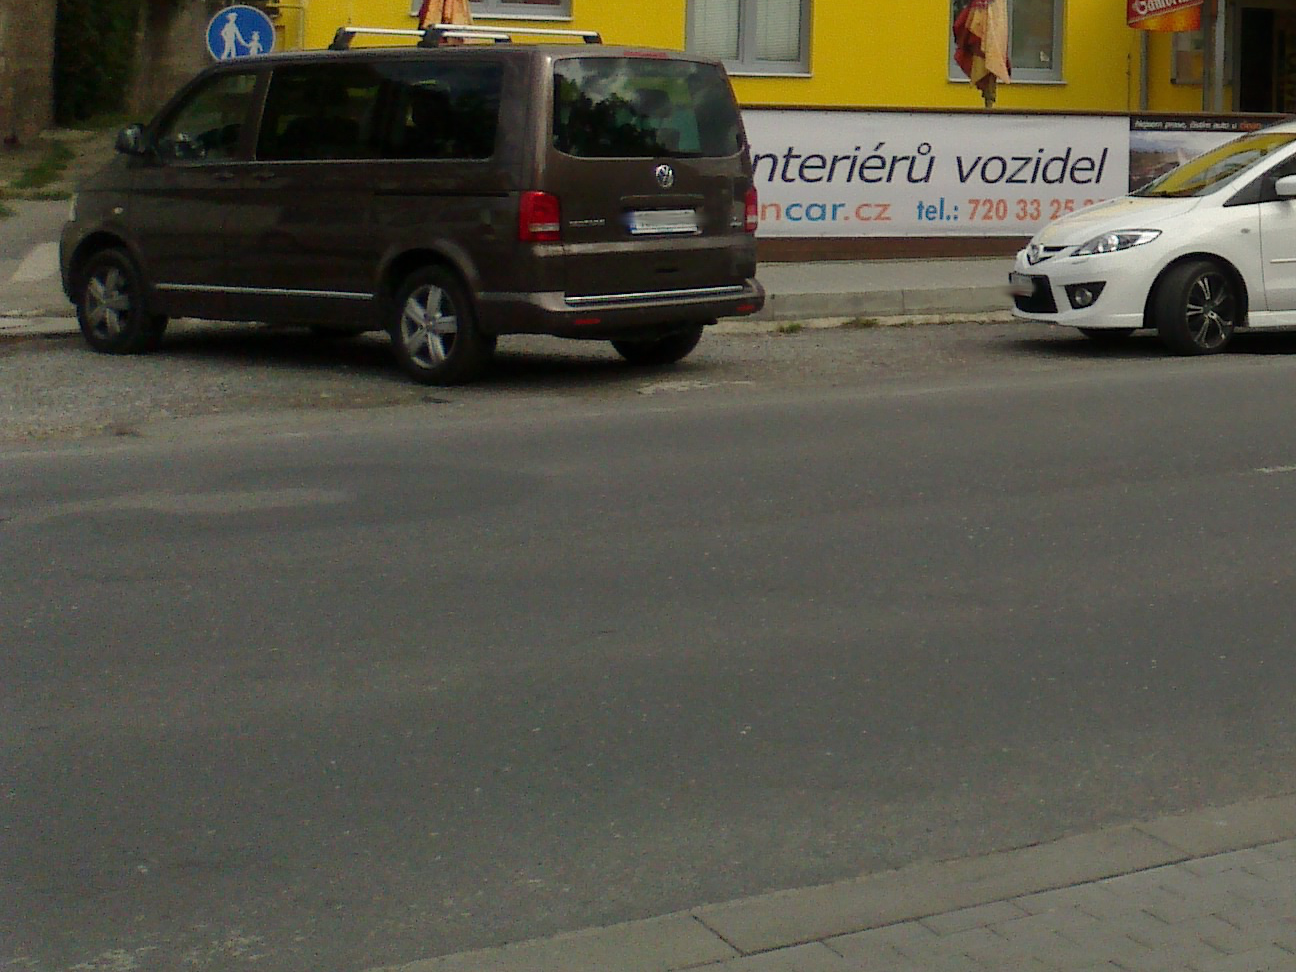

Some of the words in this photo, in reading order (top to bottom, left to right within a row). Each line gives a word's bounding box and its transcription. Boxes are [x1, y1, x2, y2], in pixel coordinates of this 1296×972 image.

[751, 141, 938, 183] nteriérů
[956, 147, 1109, 184] vozidel
[759, 201, 892, 222] ncar.cz
[917, 197, 959, 221] tel.:
[968, 198, 1008, 221] 720
[1016, 198, 1042, 221] 33
